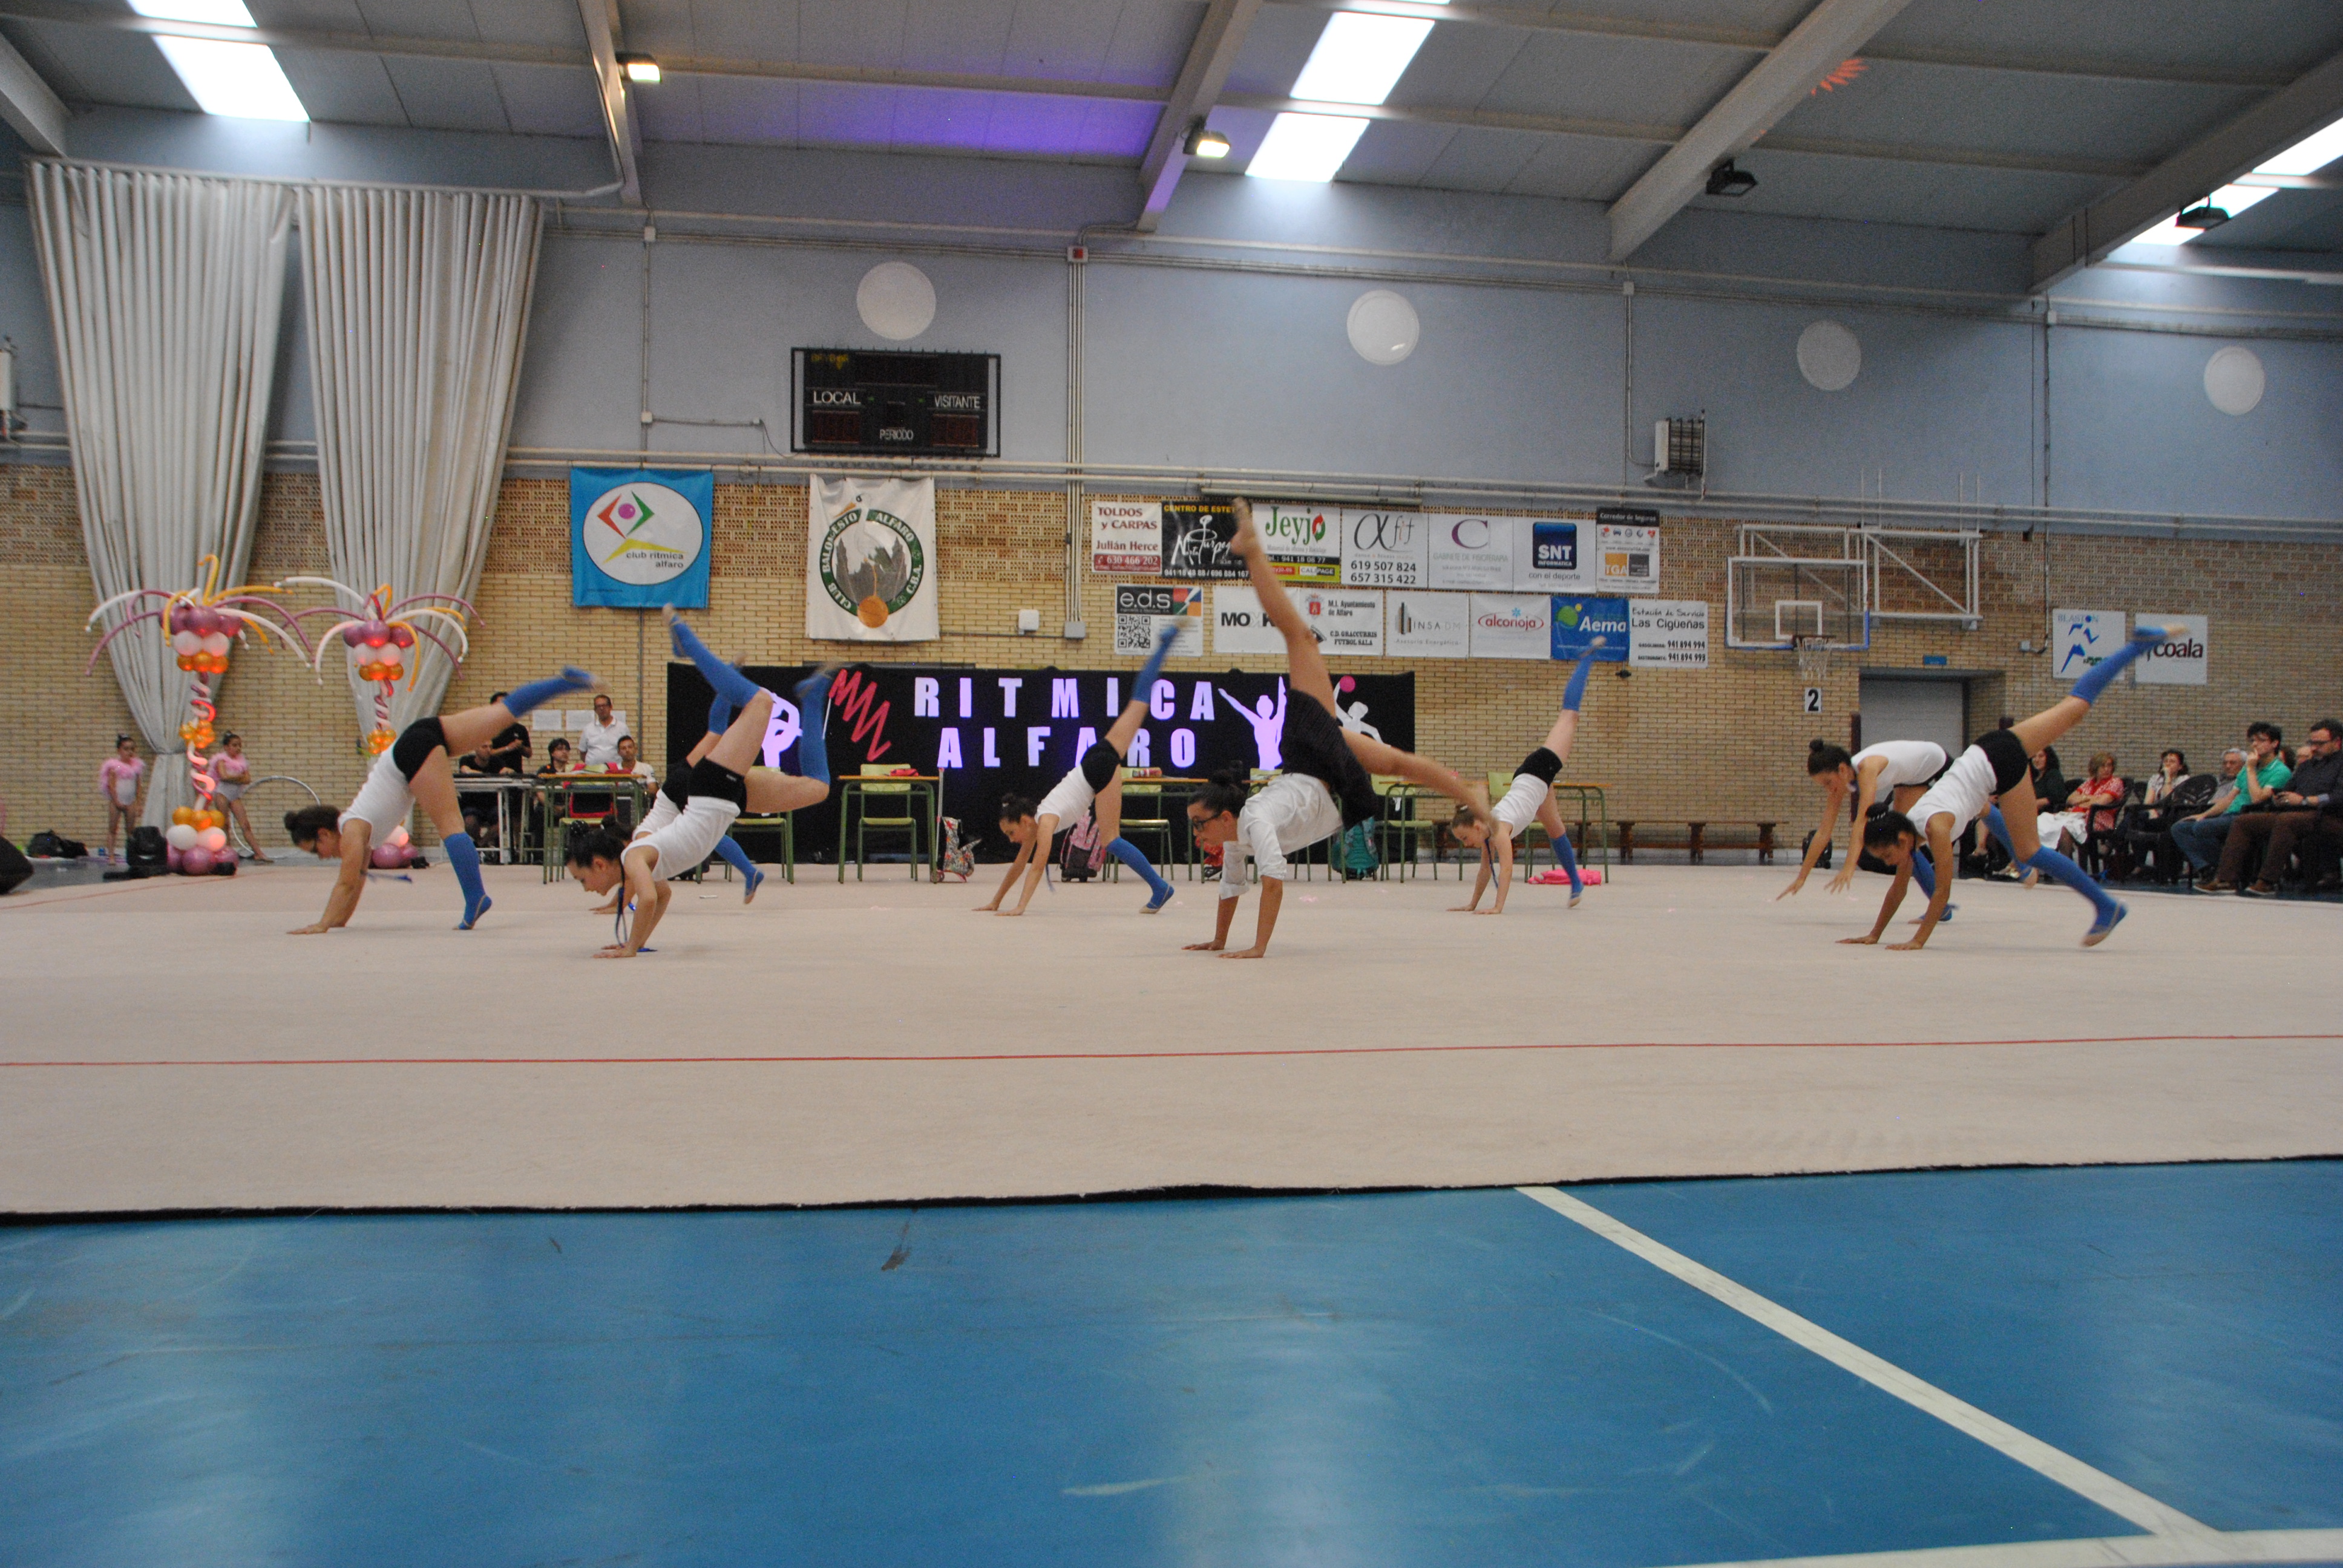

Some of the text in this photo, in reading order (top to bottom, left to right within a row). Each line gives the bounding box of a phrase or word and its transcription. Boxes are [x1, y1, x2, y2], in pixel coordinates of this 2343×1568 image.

[813, 391, 861, 405] LOCAL
[934, 396, 980, 408] VISITANTE
[879, 429, 914, 440] PERIODO
[1098, 506, 1143, 517] TOLDOS
[1101, 520, 1158, 530] y CARPAS
[1265, 505, 1325, 545] Jeyjo
[1451, 518, 1488, 549] C
[1096, 540, 1158, 550] Julián Herce
[1538, 544, 1572, 560] SNT
[828, 582, 851, 609] CLUB
[875, 512, 915, 543] ALFARO
[1106, 555, 1158, 565] 630 466 202
[1351, 560, 1417, 572] 619 507 824
[1605, 564, 1628, 575] TGA
[1351, 572, 1417, 584] 657 315 422
[1553, 572, 1581, 581] deporte
[1485, 613, 1536, 631] alcorioja
[1579, 616, 1627, 632] Aema
[1632, 618, 1650, 627] Las
[1668, 641, 1679, 649] 941
[1680, 641, 1691, 649] 894
[1807, 688, 1818, 711] 2
